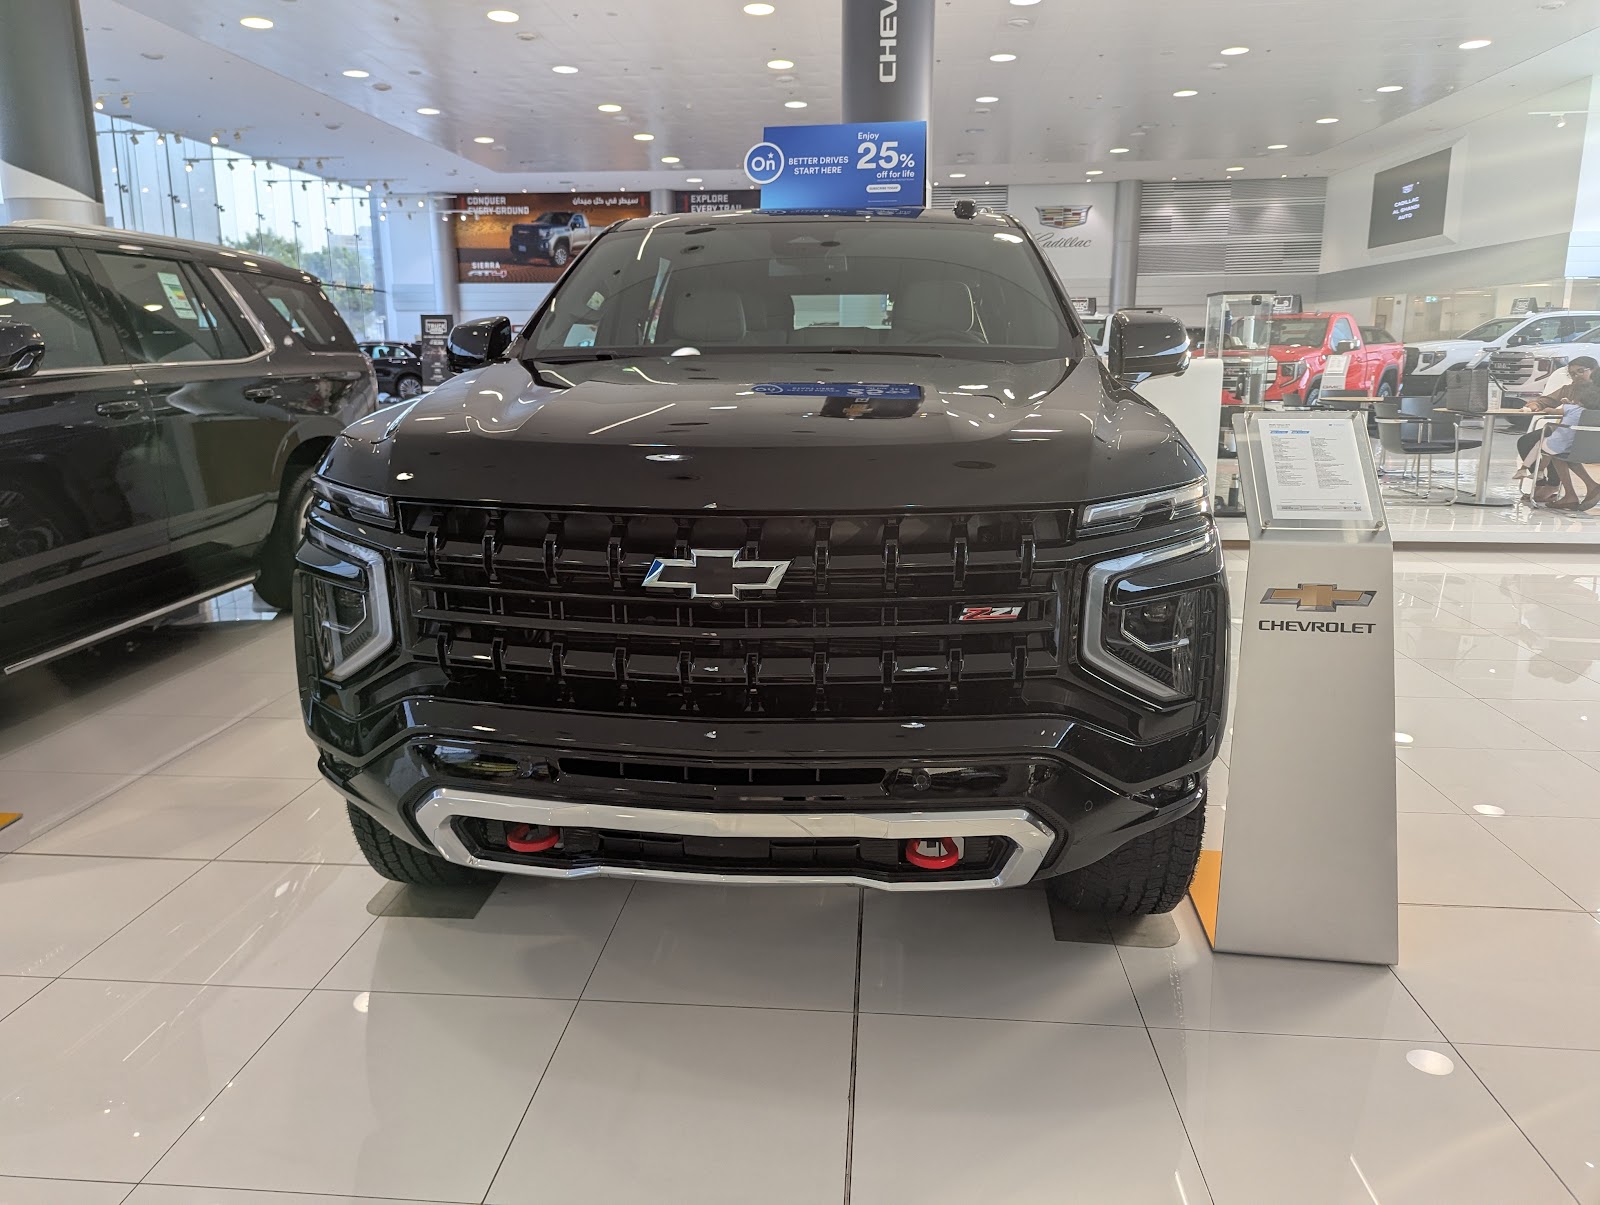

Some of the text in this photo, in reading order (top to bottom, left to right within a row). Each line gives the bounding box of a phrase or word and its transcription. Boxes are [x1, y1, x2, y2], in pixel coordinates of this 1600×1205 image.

[857, 132, 880, 141] Enjoy
[788, 156, 849, 165] BETTER DRIVES
[856, 141, 916, 170] 25%
[751, 157, 776, 172] On
[794, 166, 842, 175] START HERE
[901, 170, 915, 178] life
[466, 196, 507, 206] CONQUER
[572, 197, 639, 206] سيطر في كل ميدان
[690, 194, 729, 204] EXPLORE
[1394, 197, 1420, 207] CADILLAC
[495, 206, 530, 215] GROUND
[1033, 232, 1092, 249] Cadillac
[471, 261, 501, 270] SIERRA
[958, 606, 1023, 621] Z71
[1258, 620, 1377, 634] CHEVROLET
